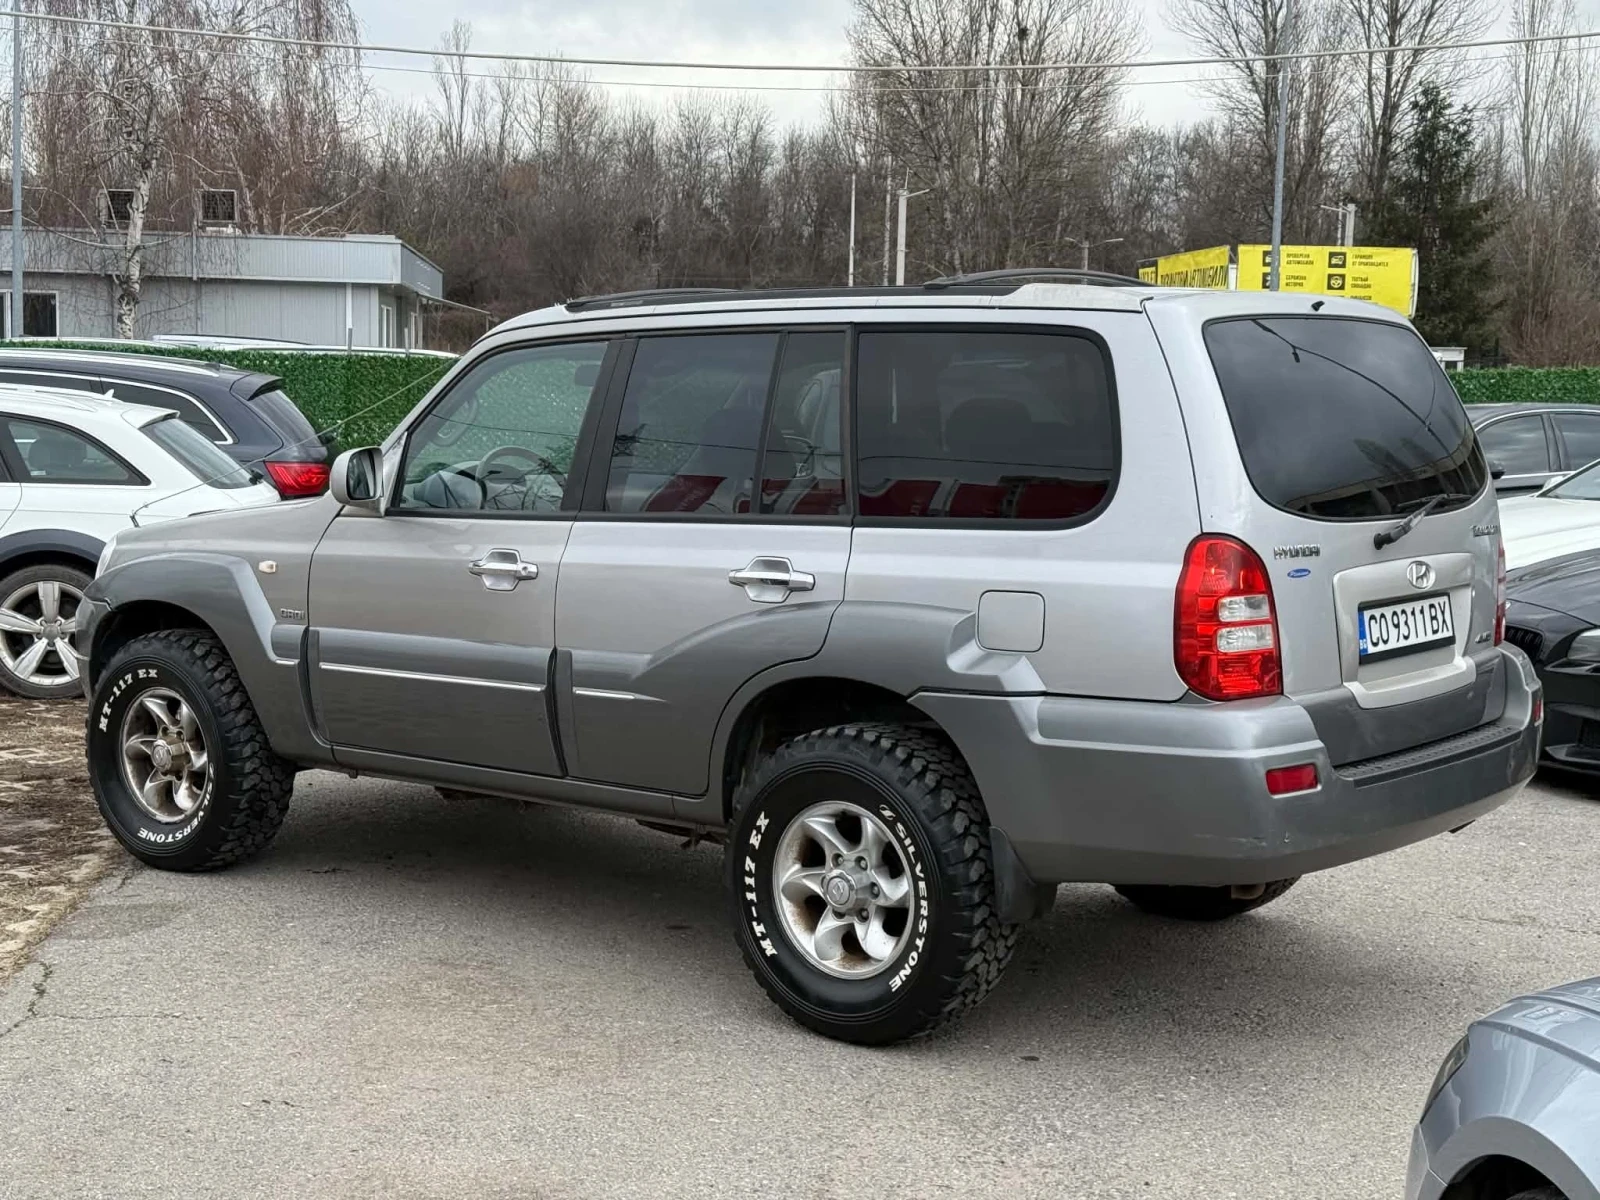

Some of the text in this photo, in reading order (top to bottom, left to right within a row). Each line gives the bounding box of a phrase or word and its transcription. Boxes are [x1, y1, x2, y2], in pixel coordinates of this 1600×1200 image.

[1273, 544, 1321, 560] HYUNDAI
[99, 668, 158, 732] MT-117 EX
[744, 811, 778, 957] MT-117 EX
[889, 822, 929, 992] SILVERSTONE
